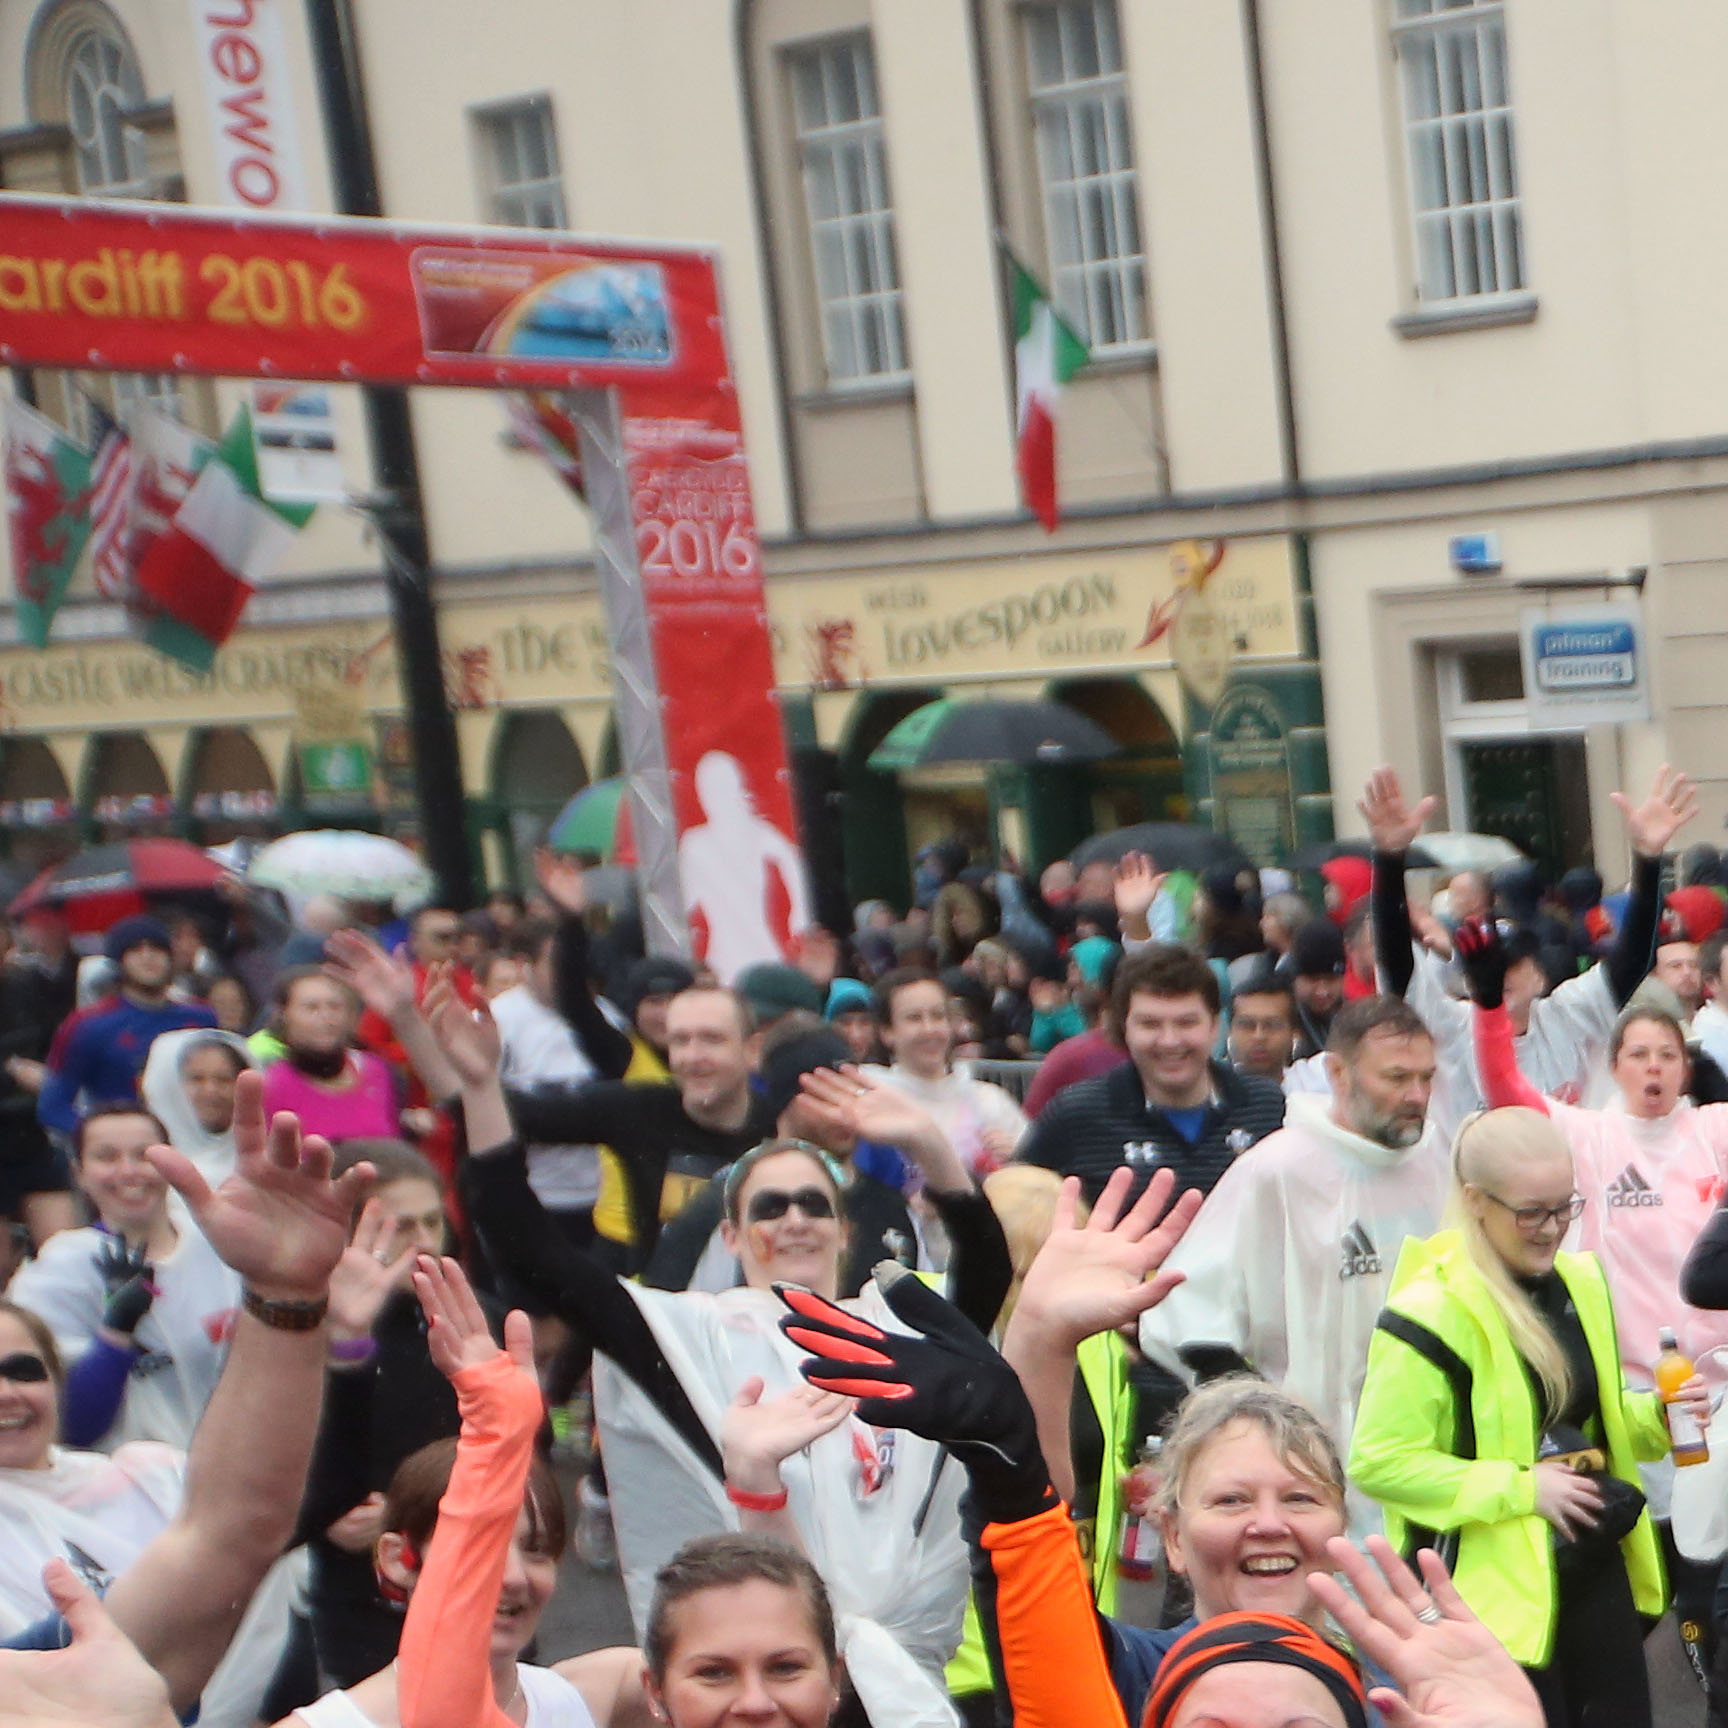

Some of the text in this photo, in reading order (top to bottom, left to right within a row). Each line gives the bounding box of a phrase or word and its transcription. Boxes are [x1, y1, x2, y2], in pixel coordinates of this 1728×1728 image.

[201, 252, 367, 331] 2016
[636, 518, 757, 577] 2016
[1545, 659, 1624, 679] training
